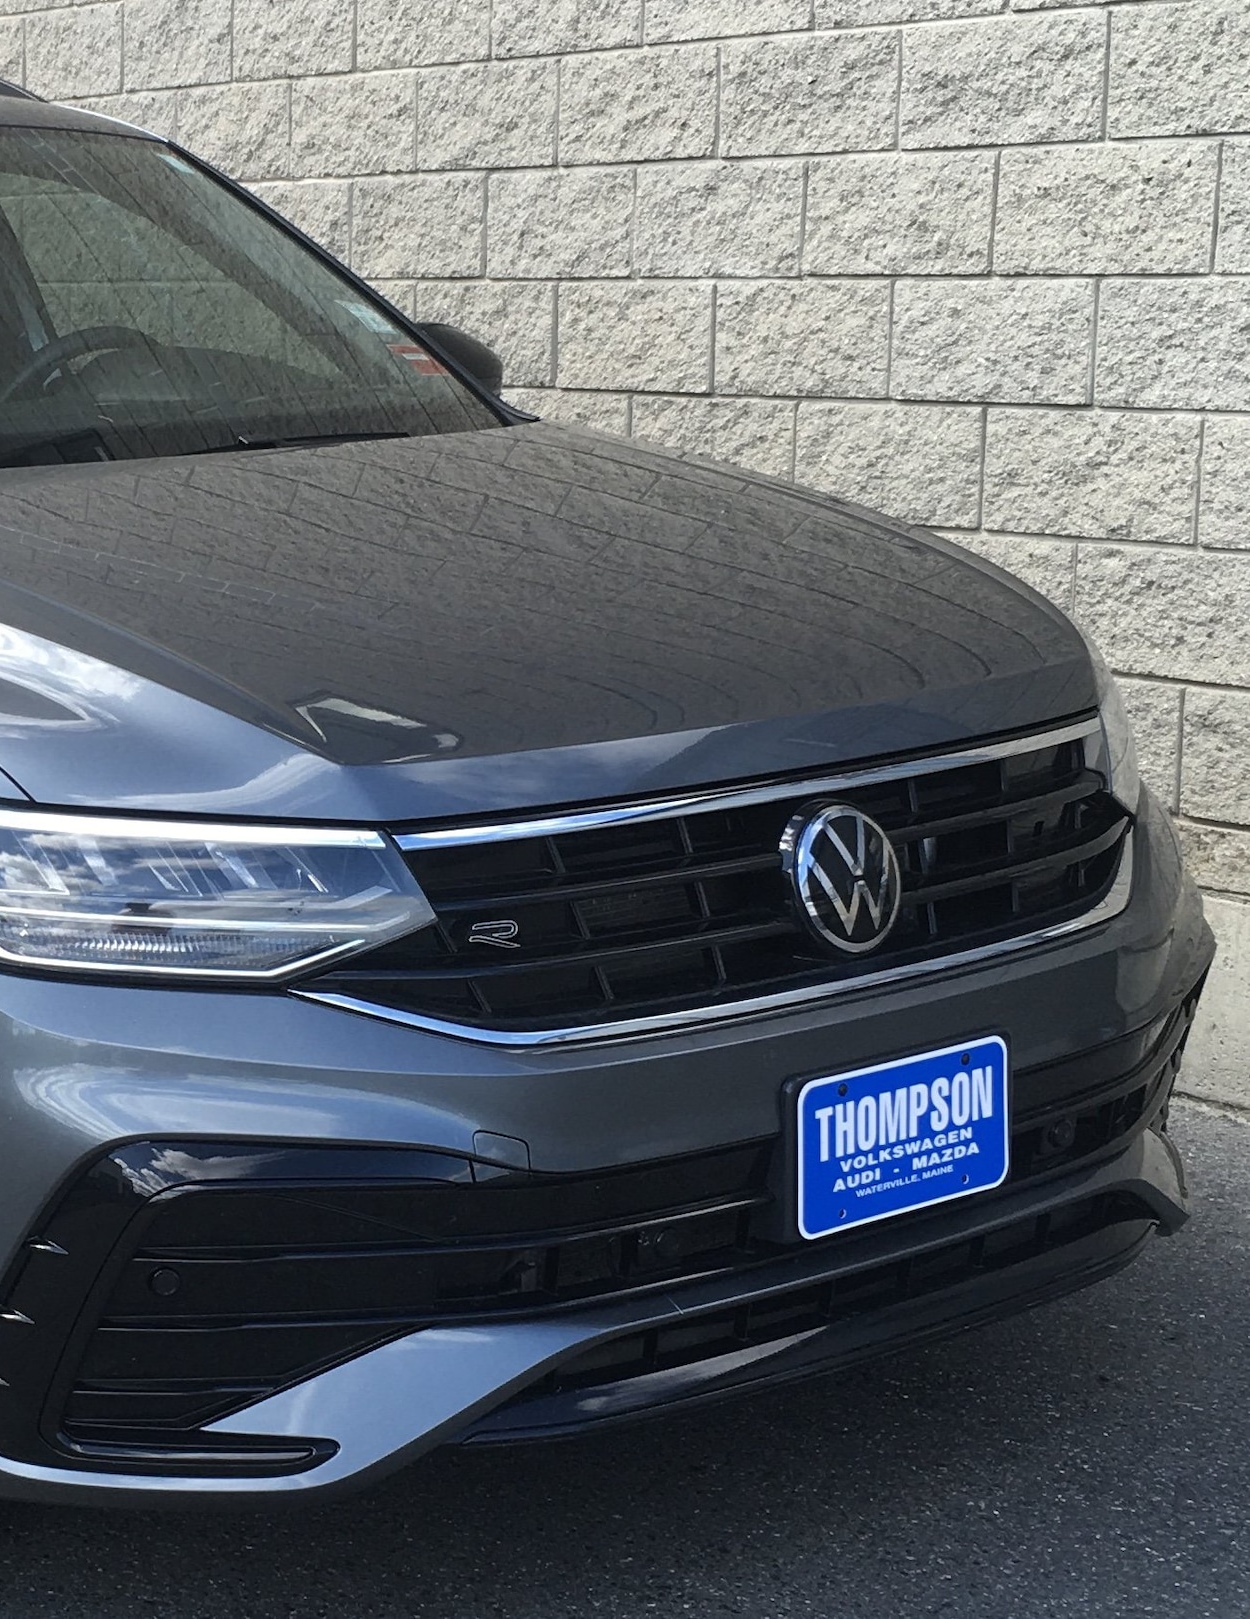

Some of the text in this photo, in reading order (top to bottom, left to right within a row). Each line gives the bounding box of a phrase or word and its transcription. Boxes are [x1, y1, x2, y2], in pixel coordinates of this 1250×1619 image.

[468, 919, 521, 949] R
[814, 1065, 993, 1163] THOMPSON
[832, 1167, 881, 1192] AUDI
[911, 1142, 980, 1171] MAZDA
[839, 1126, 973, 1172] VOLKSWAGEN
[922, 1164, 954, 1180] MAINE
